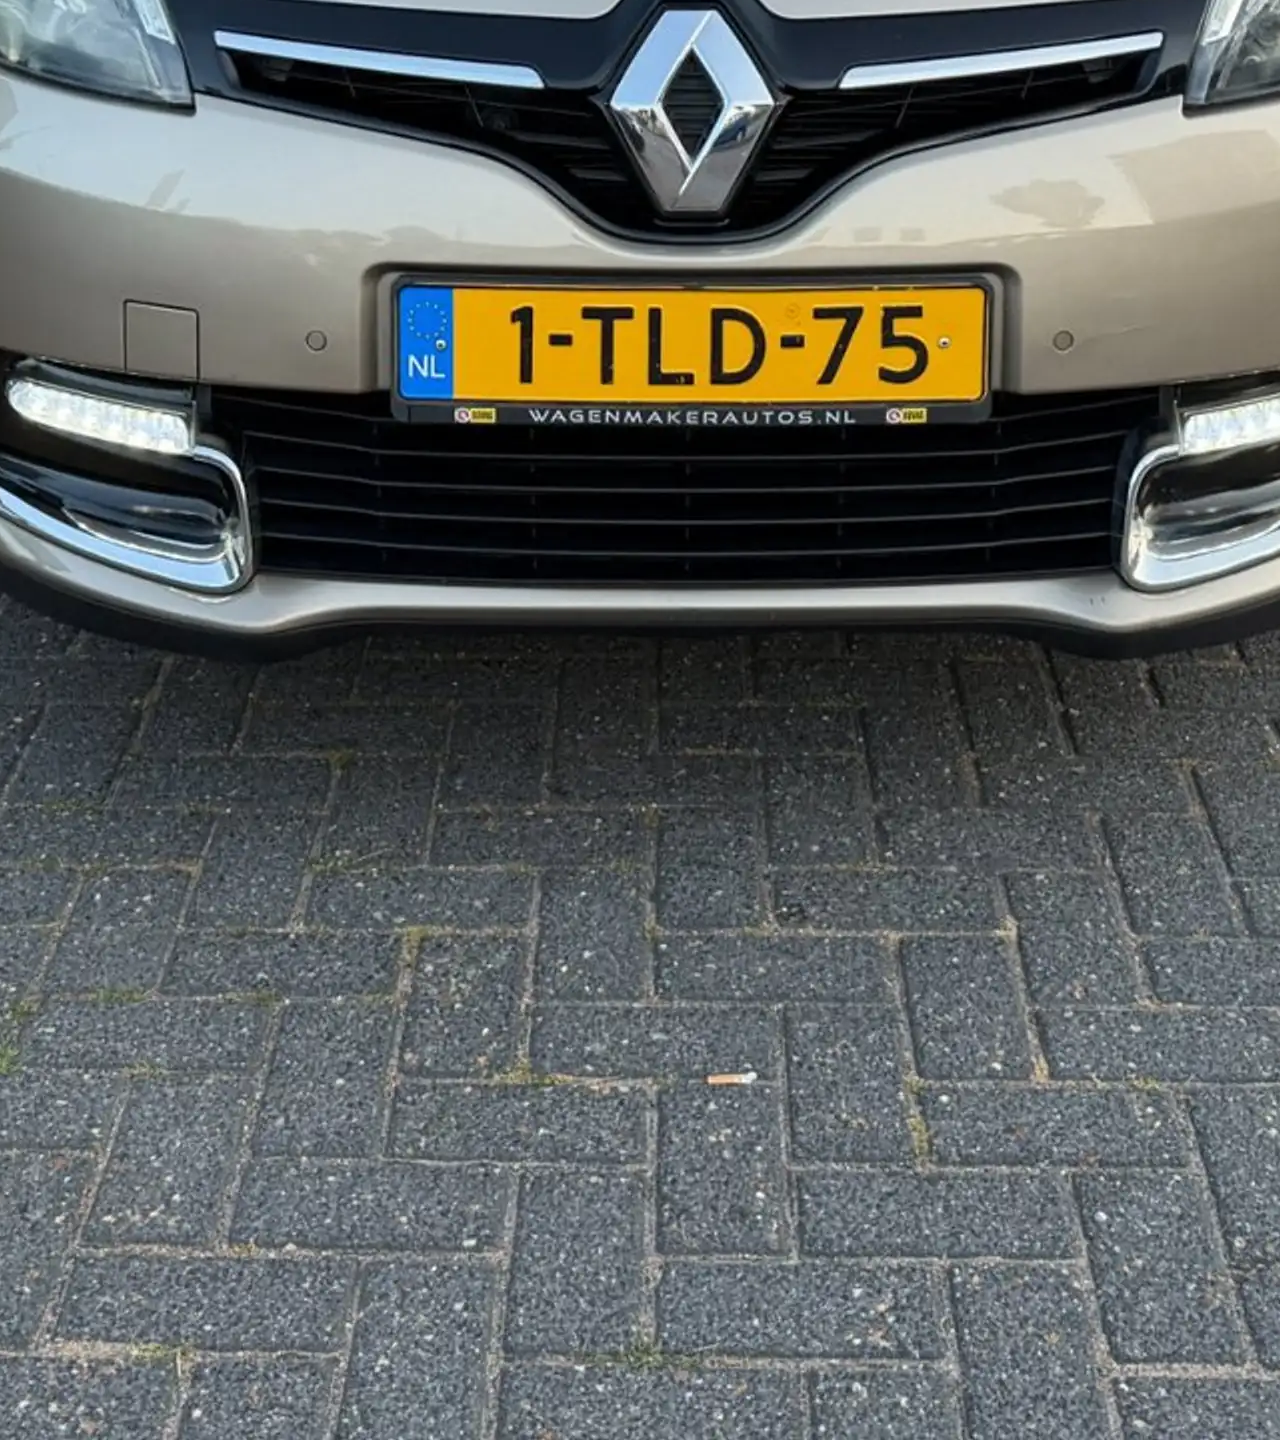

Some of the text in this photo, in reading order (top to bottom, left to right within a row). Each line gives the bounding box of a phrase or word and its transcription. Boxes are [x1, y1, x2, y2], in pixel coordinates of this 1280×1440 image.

[407, 305, 930, 386] NL 1-TLD-75
[528, 407, 857, 426] WAGENMAKERAUTOS.NL
